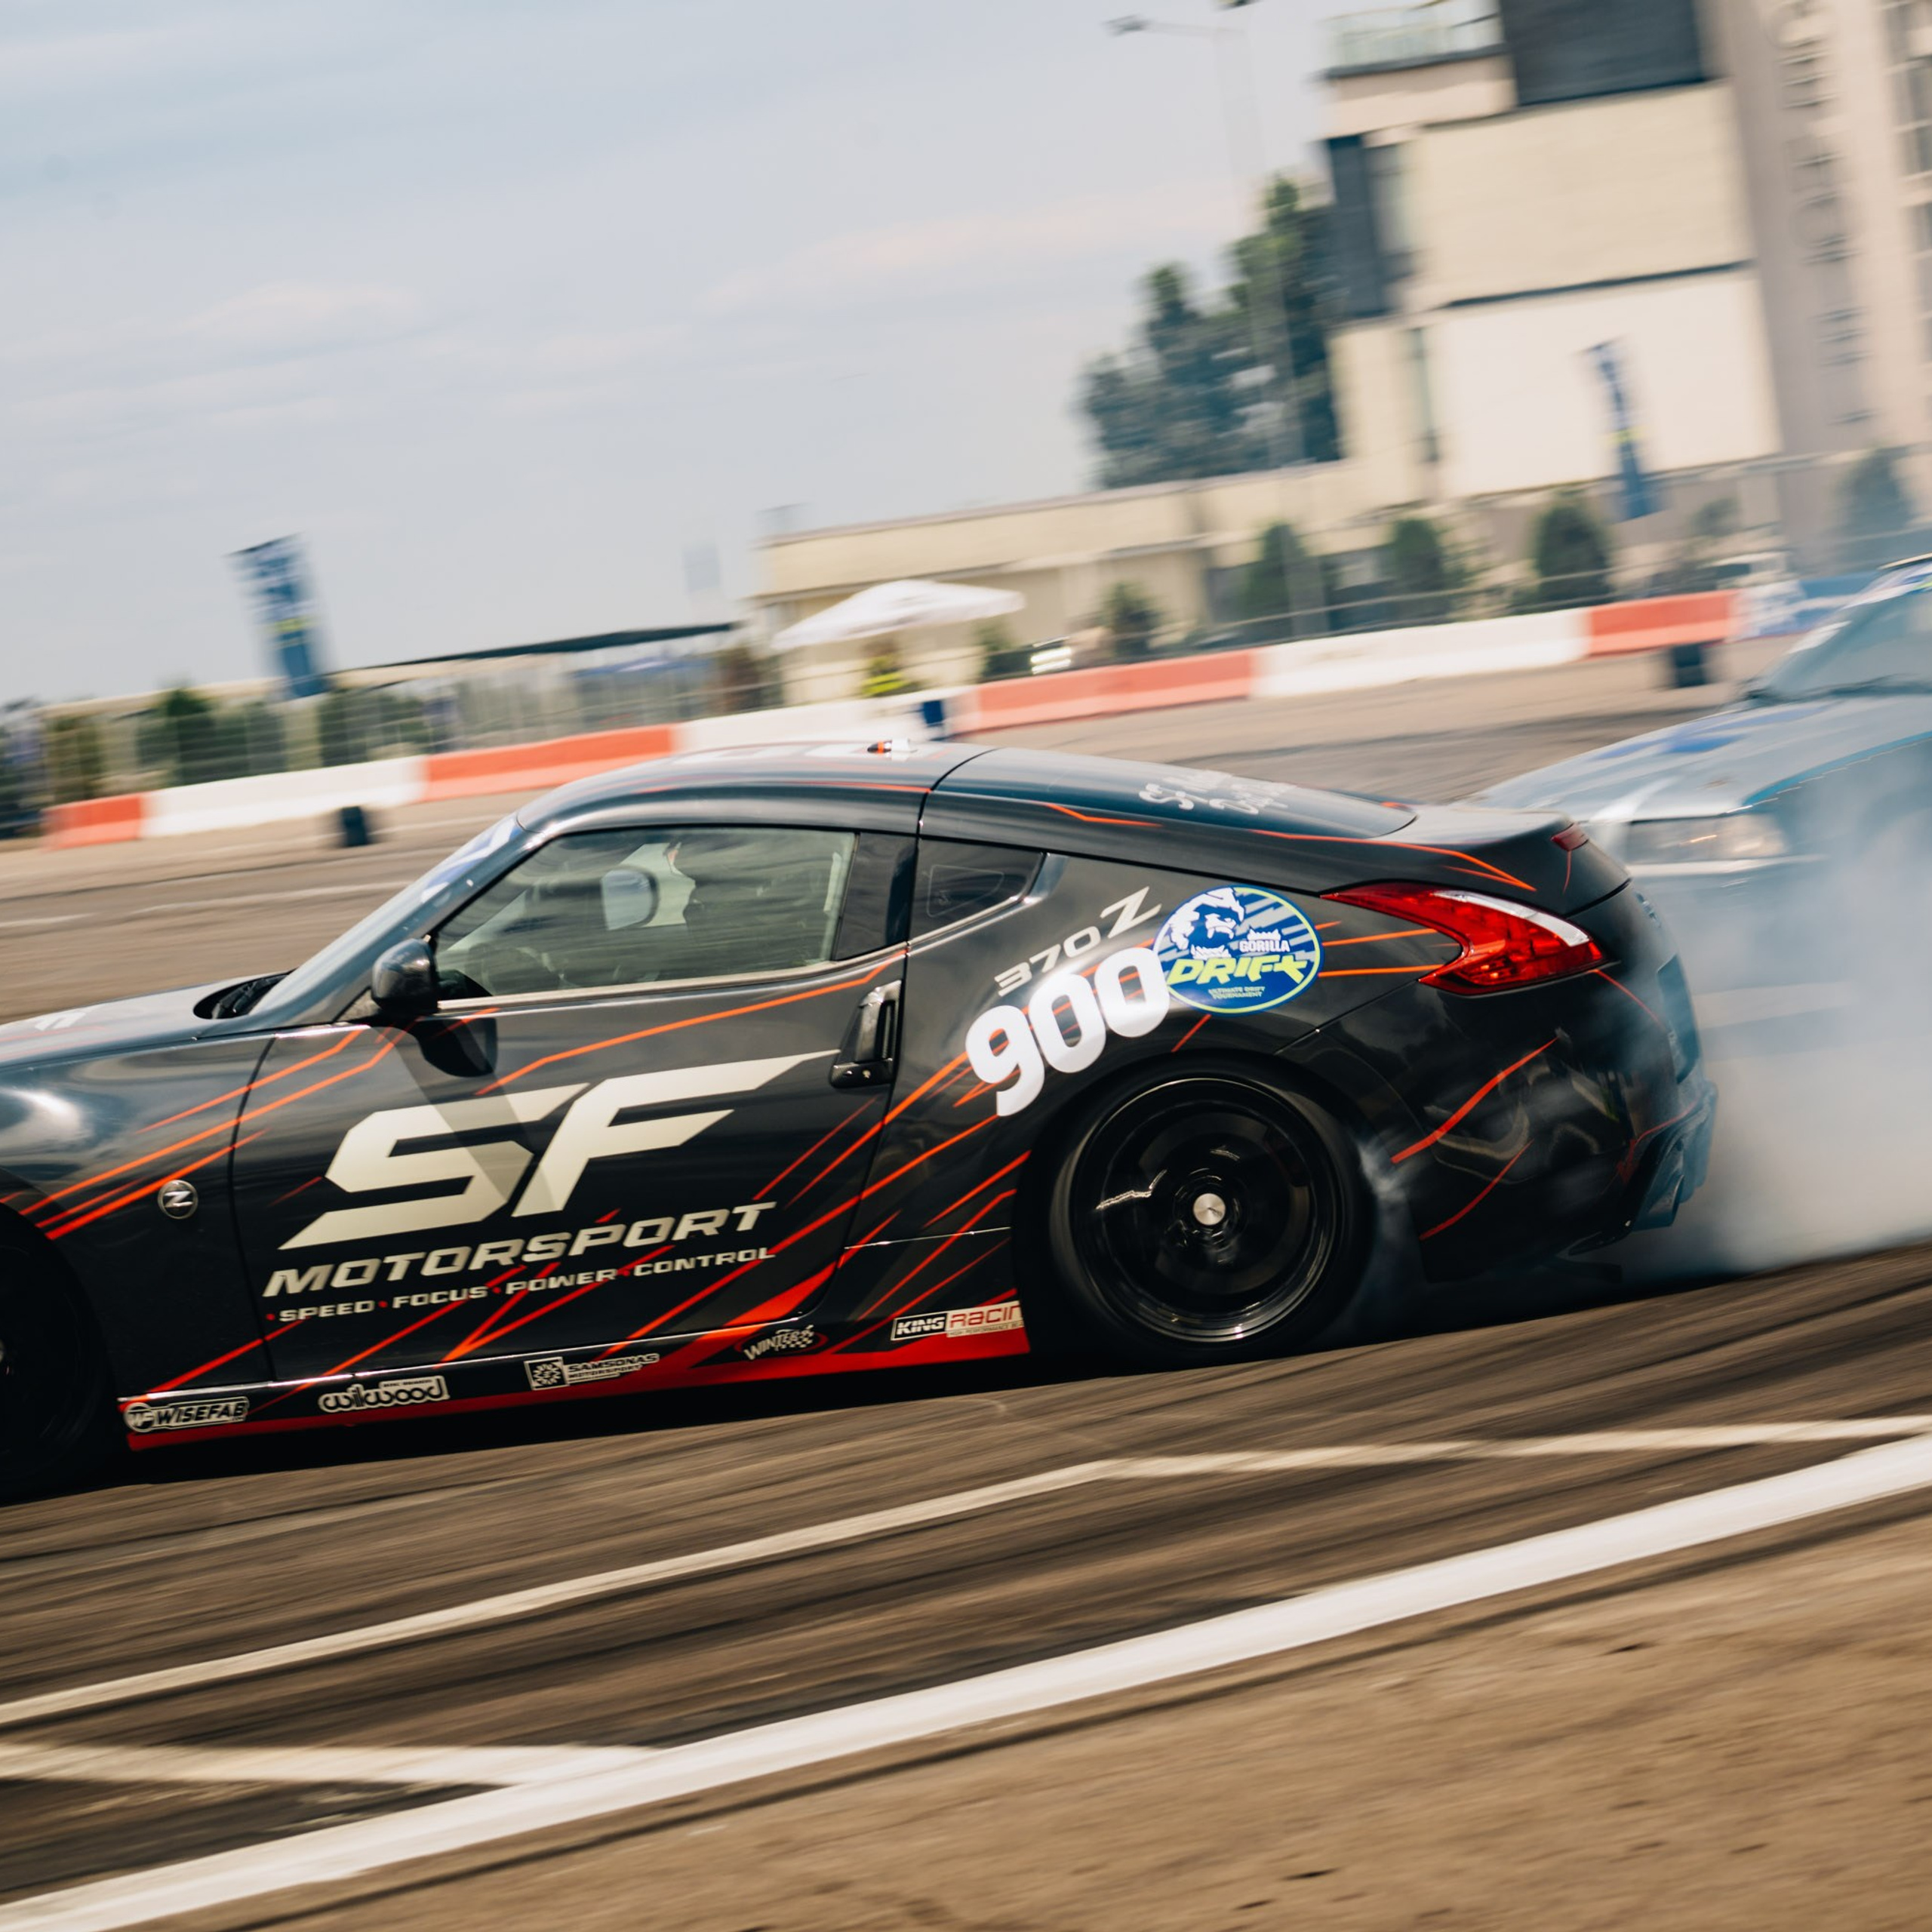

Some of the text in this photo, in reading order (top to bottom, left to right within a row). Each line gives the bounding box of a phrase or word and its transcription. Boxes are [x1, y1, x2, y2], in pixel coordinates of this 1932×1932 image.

[1239, 940, 1291, 952] GORILLA
[1167, 955, 1308, 984] DRIFT
[965, 947, 1171, 1117] 900
[276, 1049, 841, 1250] SF
[262, 1201, 777, 1297] MOTORSPORT
[279, 1247, 777, 1321] SPEED FOCUS POWER CONTROL
[897, 1317, 945, 1335] KING
[568, 1353, 659, 1372] SAMSONAS
[568, 1364, 641, 1378] MOTORSPORT
[322, 1377, 445, 1411] wilwood
[155, 1402, 246, 1425] WISEFAB
